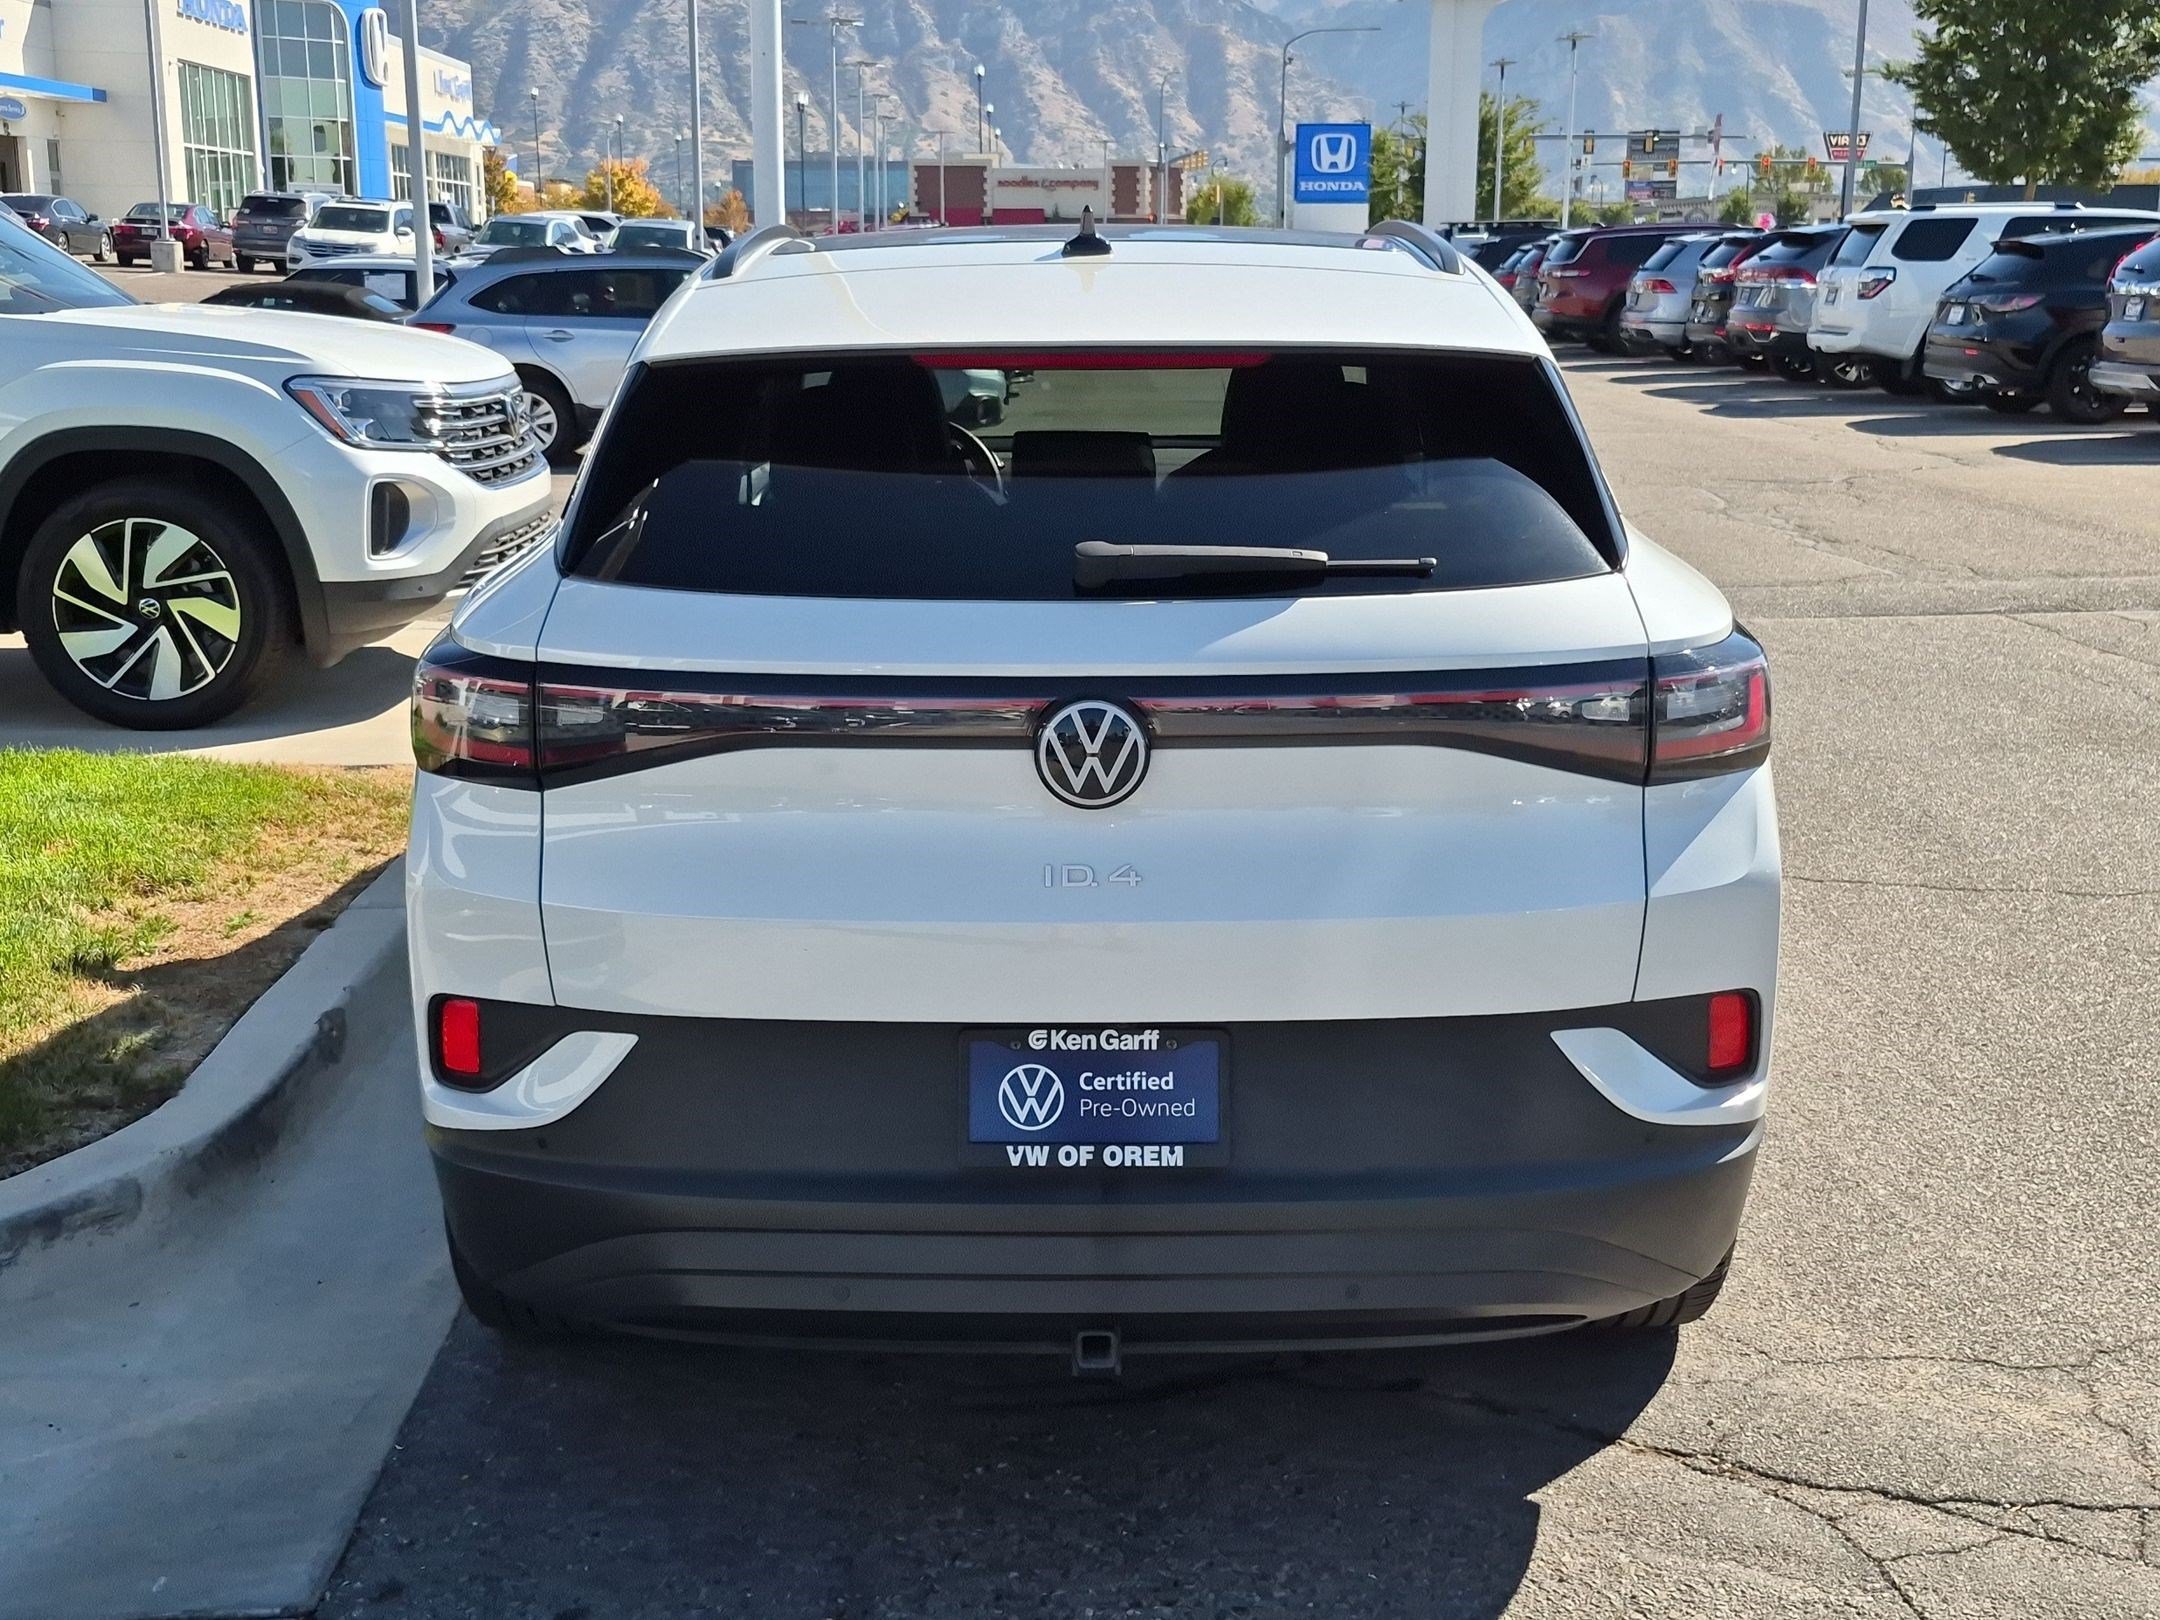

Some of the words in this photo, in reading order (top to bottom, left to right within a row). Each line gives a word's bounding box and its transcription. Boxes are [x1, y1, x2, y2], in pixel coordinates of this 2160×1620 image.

[997, 175, 1039, 187] noodles
[1049, 180, 1099, 191] company
[1300, 181, 1366, 192] HONDA
[1050, 1029, 1098, 1051] Ken
[1100, 1029, 1160, 1051] Garff
[1079, 1071, 1175, 1091] Certified
[1079, 1098, 1196, 1118] Pre-Owned
[1006, 1145, 1050, 1167] VW
[1058, 1145, 1095, 1167] OF
[1102, 1145, 1184, 1167] OREM
